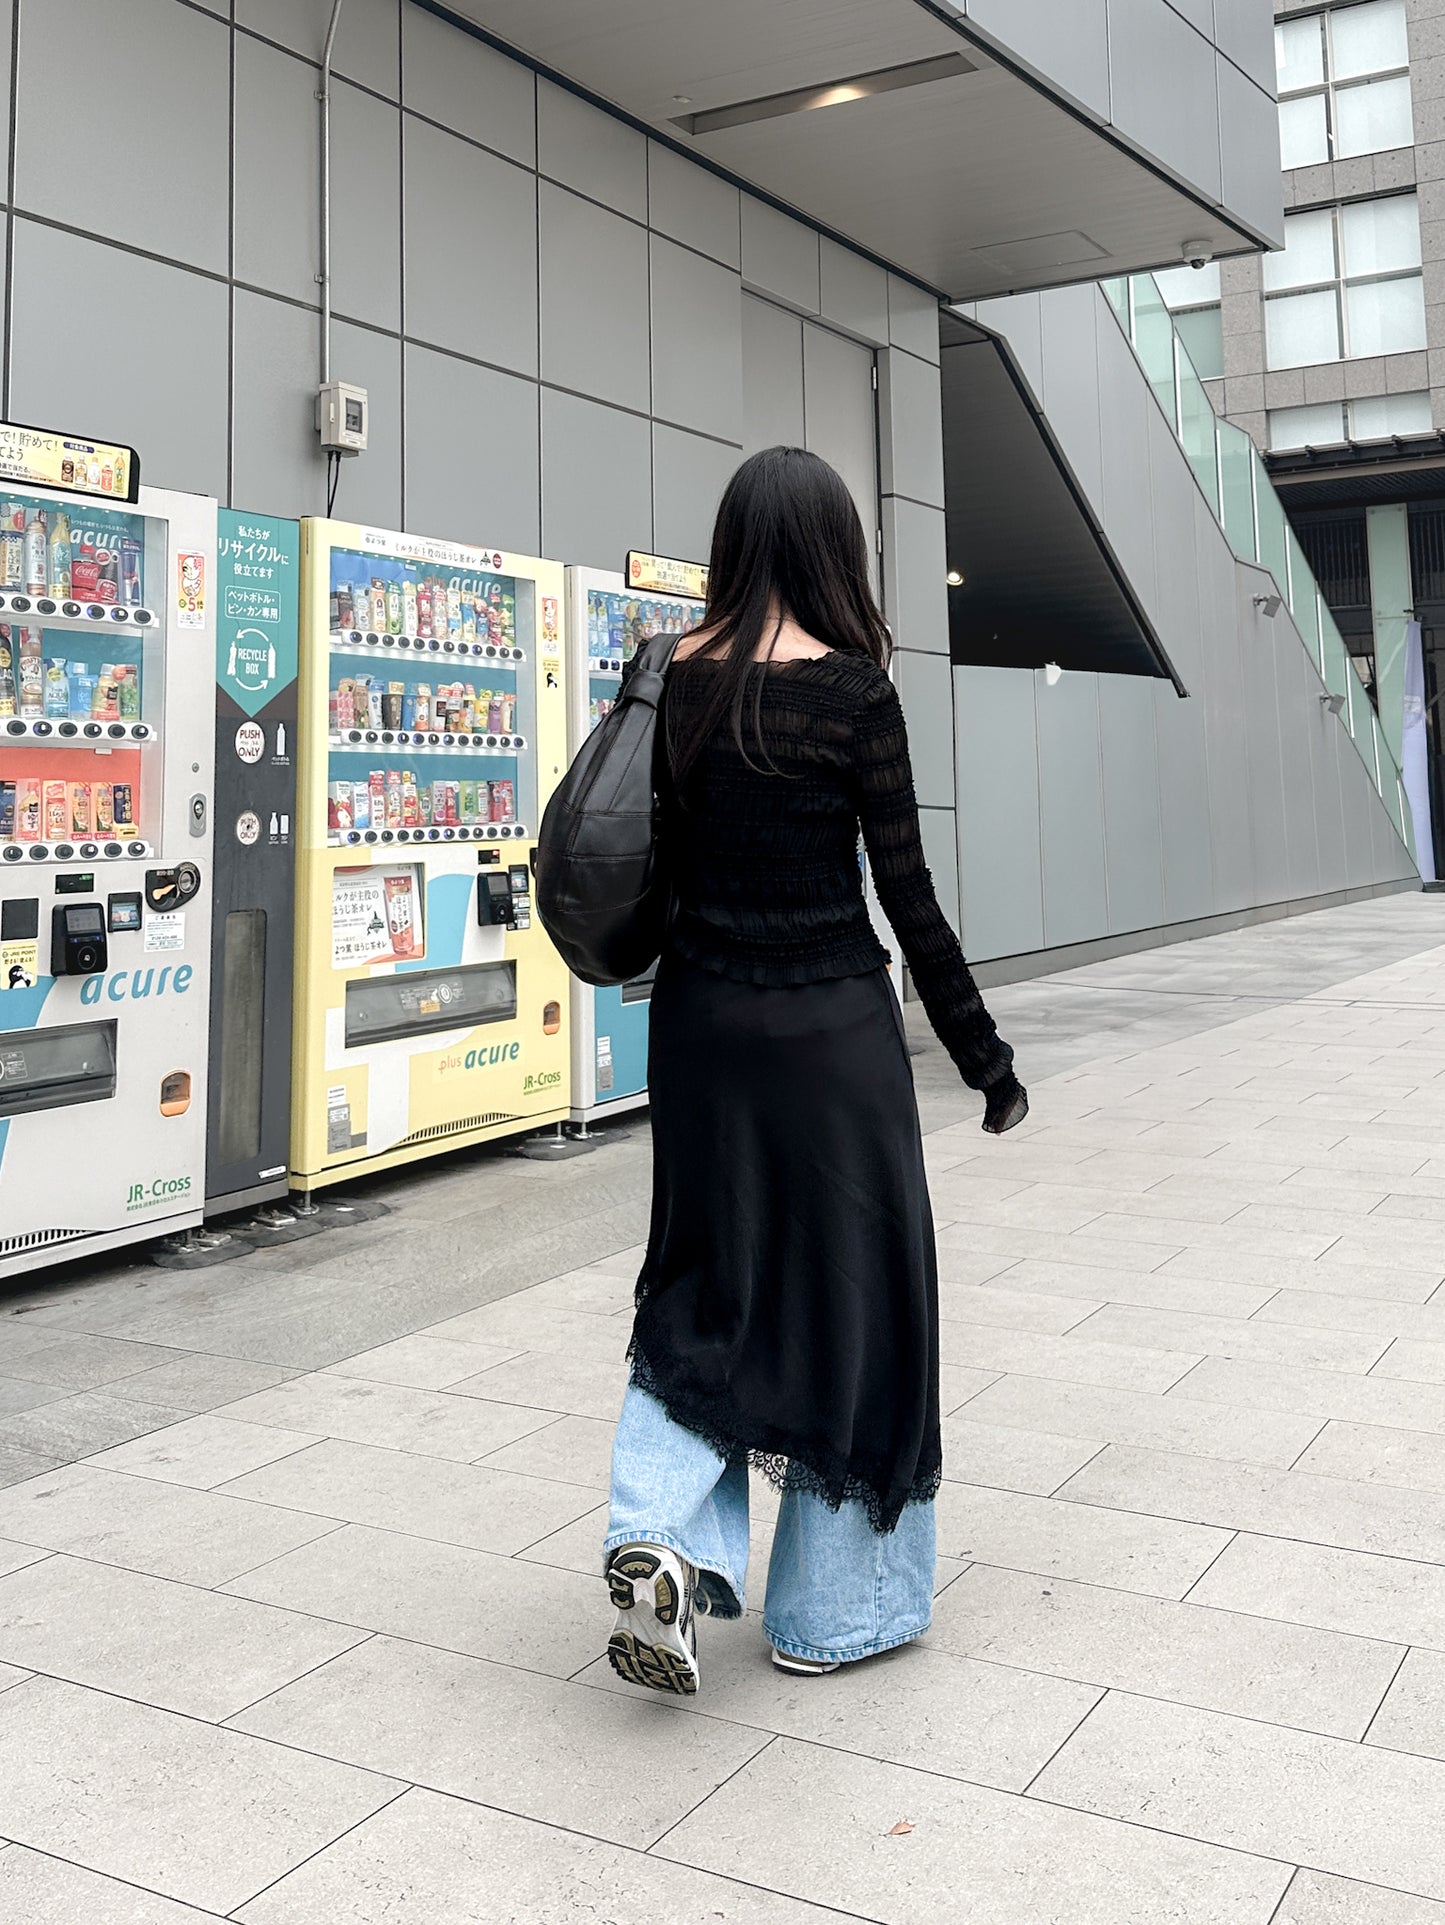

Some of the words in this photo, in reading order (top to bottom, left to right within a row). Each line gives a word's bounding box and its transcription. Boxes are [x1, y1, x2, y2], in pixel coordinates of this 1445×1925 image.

[70, 529, 121, 549] acur
[238, 525, 270, 540] 私たちが
[218, 537, 289, 565] リサイクルに
[234, 562, 274, 579] 役立てます
[228, 603, 278, 620] ビン・カン専用
[238, 648, 267, 661] RECYCLE
[245, 662, 260, 675] BOX
[239, 729, 260, 740] PUSH
[238, 747, 260, 757] ONLY
[333, 889, 379, 903] ルクが主役の
[354, 940, 387, 952] ほうじ茶オレ
[80, 964, 193, 1006] acure
[438, 1055, 462, 1074] plus
[464, 1042, 520, 1070] acure
[523, 1071, 561, 1090] JR-Cross
[127, 1176, 192, 1204] JR-Cross
